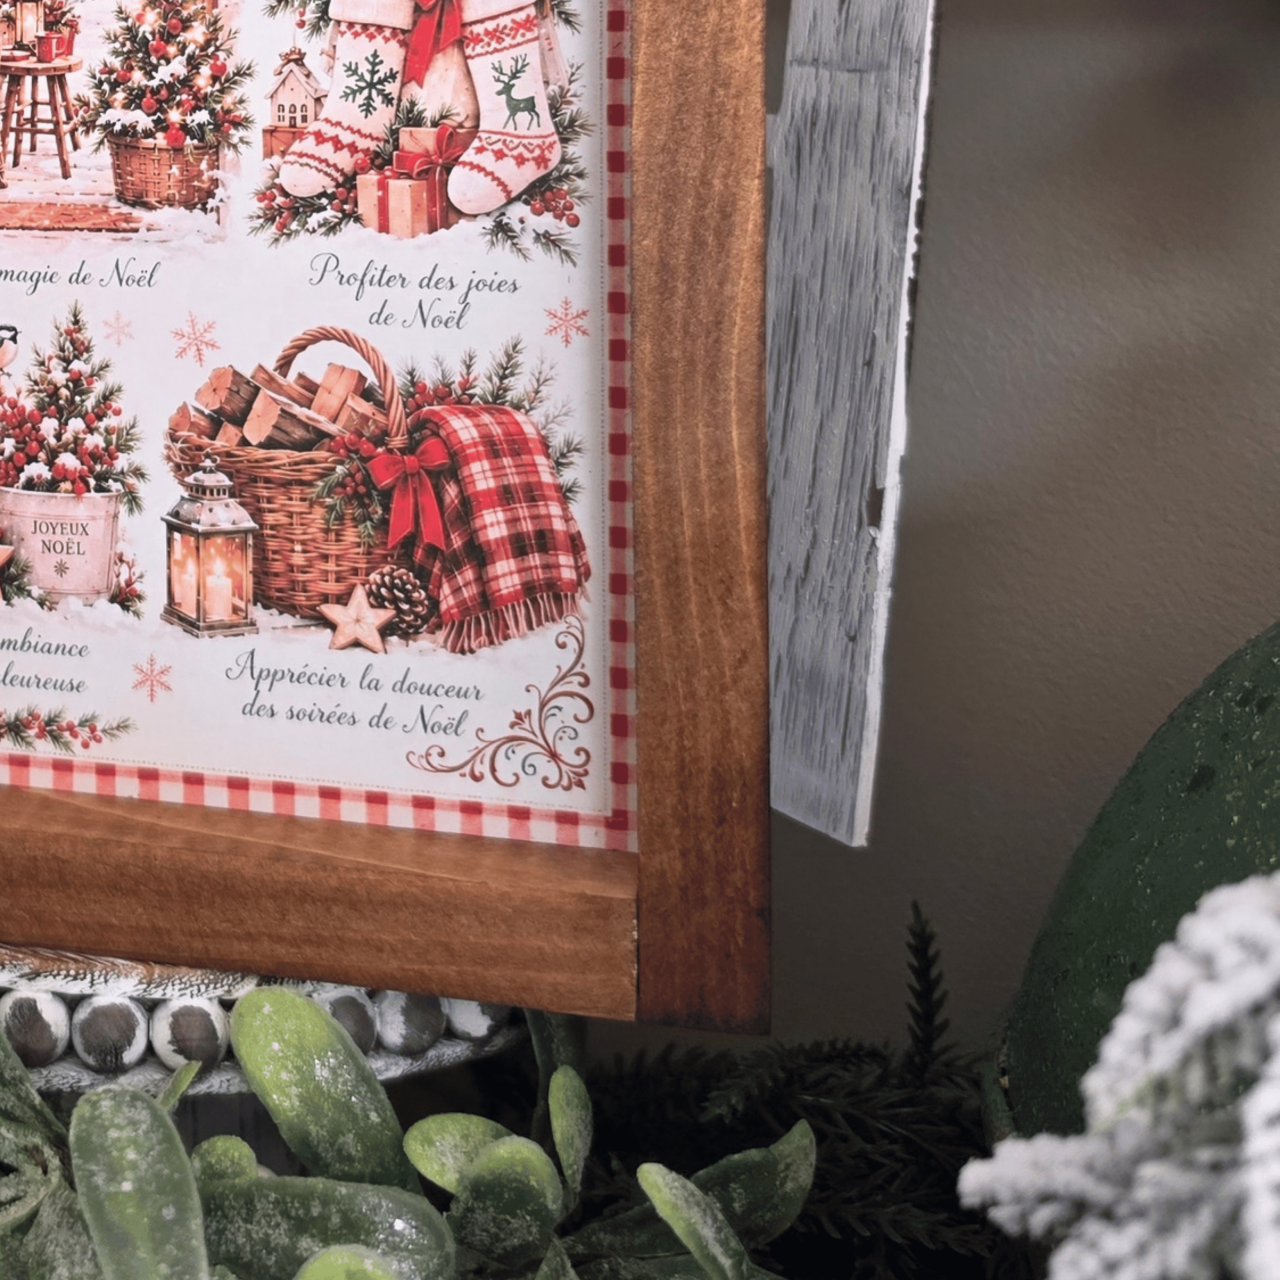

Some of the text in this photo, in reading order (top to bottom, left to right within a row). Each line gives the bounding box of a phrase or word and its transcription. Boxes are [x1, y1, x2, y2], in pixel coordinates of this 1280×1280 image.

[68, 260, 93, 286] de
[99, 257, 161, 288] Noël
[309, 252, 522, 305] Profiter des joies
[368, 297, 471, 330] de Noël
[31, 520, 90, 536] JOYEUX
[41, 538, 86, 555] NOËL
[225, 648, 485, 701] Apprécier la douceur
[242, 690, 470, 737] des soirées de Noël
